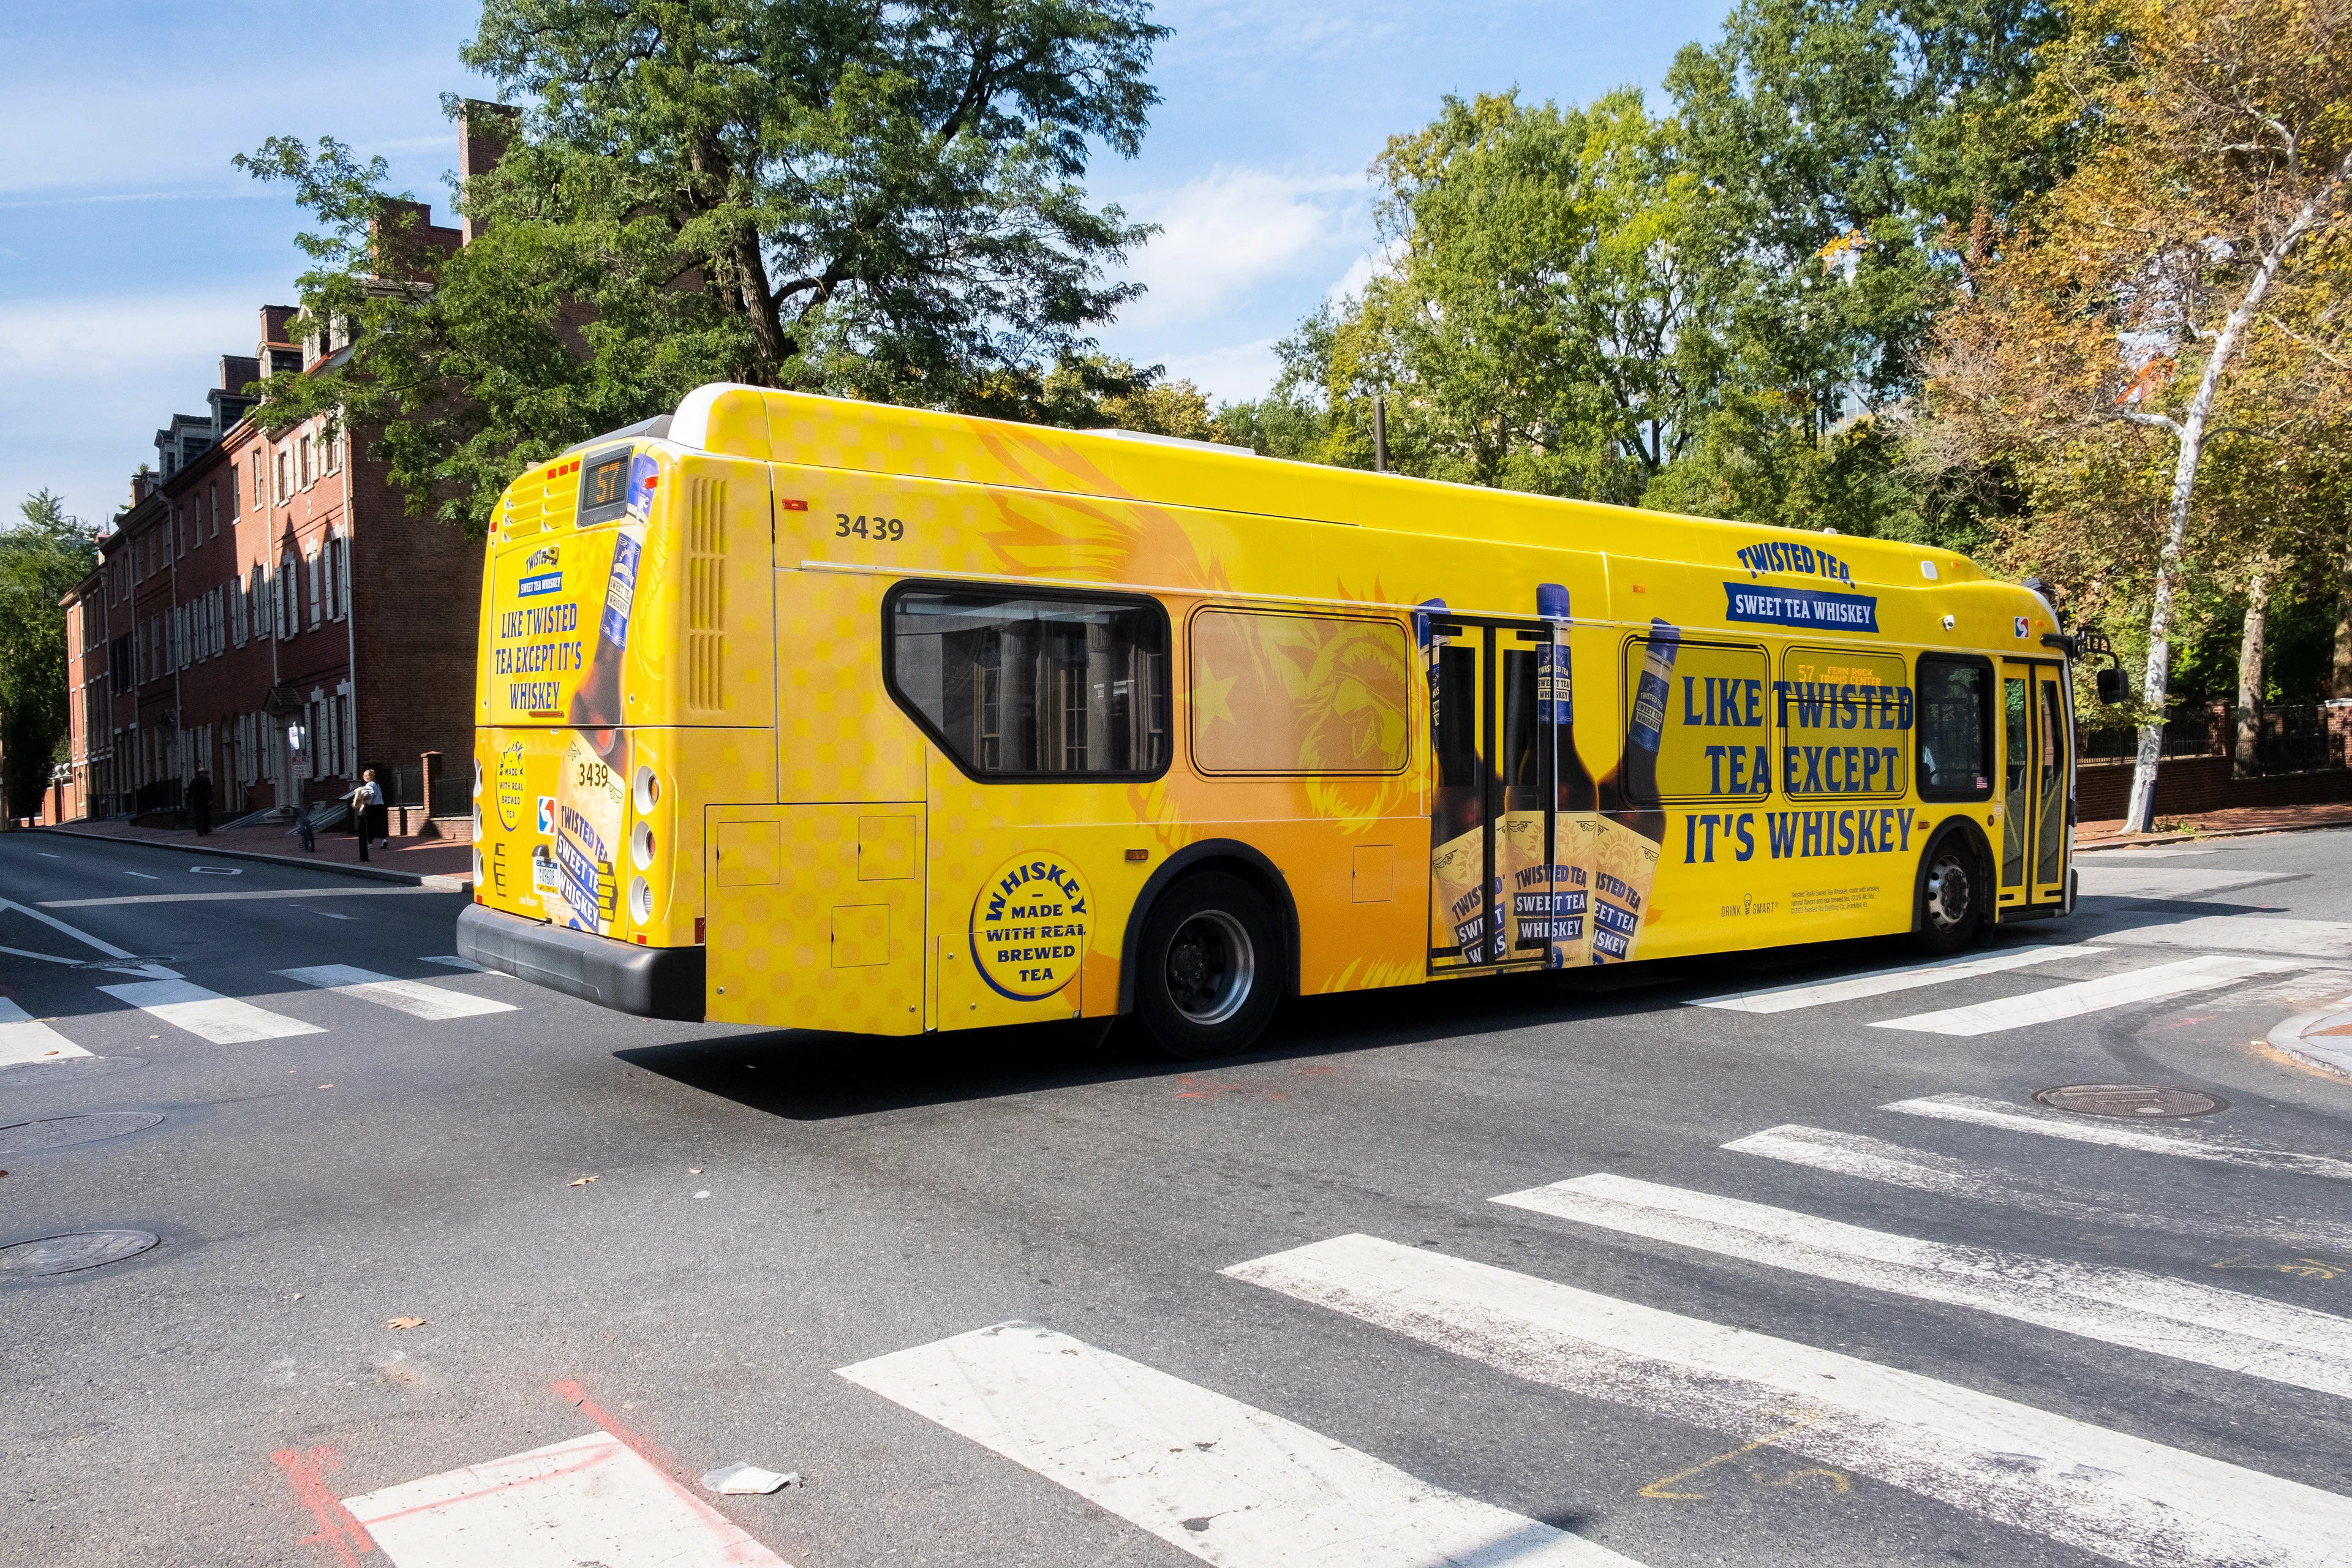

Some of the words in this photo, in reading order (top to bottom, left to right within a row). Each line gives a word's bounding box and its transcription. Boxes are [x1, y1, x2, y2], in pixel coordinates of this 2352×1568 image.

[596, 462, 620, 503] 57
[835, 513, 904, 541] 3439
[1736, 541, 1815, 579] TWISTED
[1815, 549, 1856, 590] TEA
[521, 582, 533, 594] SWEET
[541, 577, 561, 589] WHISKEY
[502, 611, 523, 638] LIKE
[527, 603, 577, 635] TWISTED
[1735, 594, 1782, 616] SWEET
[1784, 598, 1811, 619] TEA
[1812, 601, 1871, 624] WHISKEY
[496, 648, 513, 674] TEA
[516, 644, 555, 673] EXCEPT
[558, 641, 582, 670] IT'S
[1798, 665, 1814, 682] 57
[1819, 674, 1847, 684] TRANS
[1850, 676, 1881, 686] CENTER
[1828, 666, 1849, 675] FERN
[1852, 668, 1873, 676] ROCK
[510, 682, 560, 709] WHISKEY
[1641, 692, 1657, 703] TWISTED
[1682, 676, 1763, 727] LIKE
[1771, 680, 1914, 731] TWISTED
[1637, 702, 1654, 715] SWEET
[1637, 713, 1659, 730] WHISKEY
[579, 763, 608, 788] 3439
[1705, 745, 1773, 794] TEA
[1782, 745, 1900, 793] EXCEPT
[502, 796, 521, 805] BREWED
[561, 805, 594, 849] TWISTED
[1683, 813, 1755, 864] IT'S
[1766, 808, 1916, 859] WHISKEY
[558, 834, 587, 881] SWEET
[589, 867, 598, 895] TE
[1515, 864, 1569, 890] TWISTED
[1570, 865, 1587, 888] TEA
[560, 869, 599, 927] WHISKEY
[985, 862, 1087, 921] WHISKEY
[1516, 895, 1562, 911] SWEET
[1566, 894, 1585, 910] TEA
[1625, 886, 1642, 913] TEA
[1011, 904, 1063, 919] MADE
[1617, 911, 1634, 932] TEA
[1721, 905, 1741, 917] DRINK
[987, 927, 1035, 942] WITH
[1041, 924, 1086, 938] REAL
[1521, 920, 1581, 938] WHISKEY
[997, 945, 1075, 962] BREWED
[1019, 968, 1054, 982] TEA
